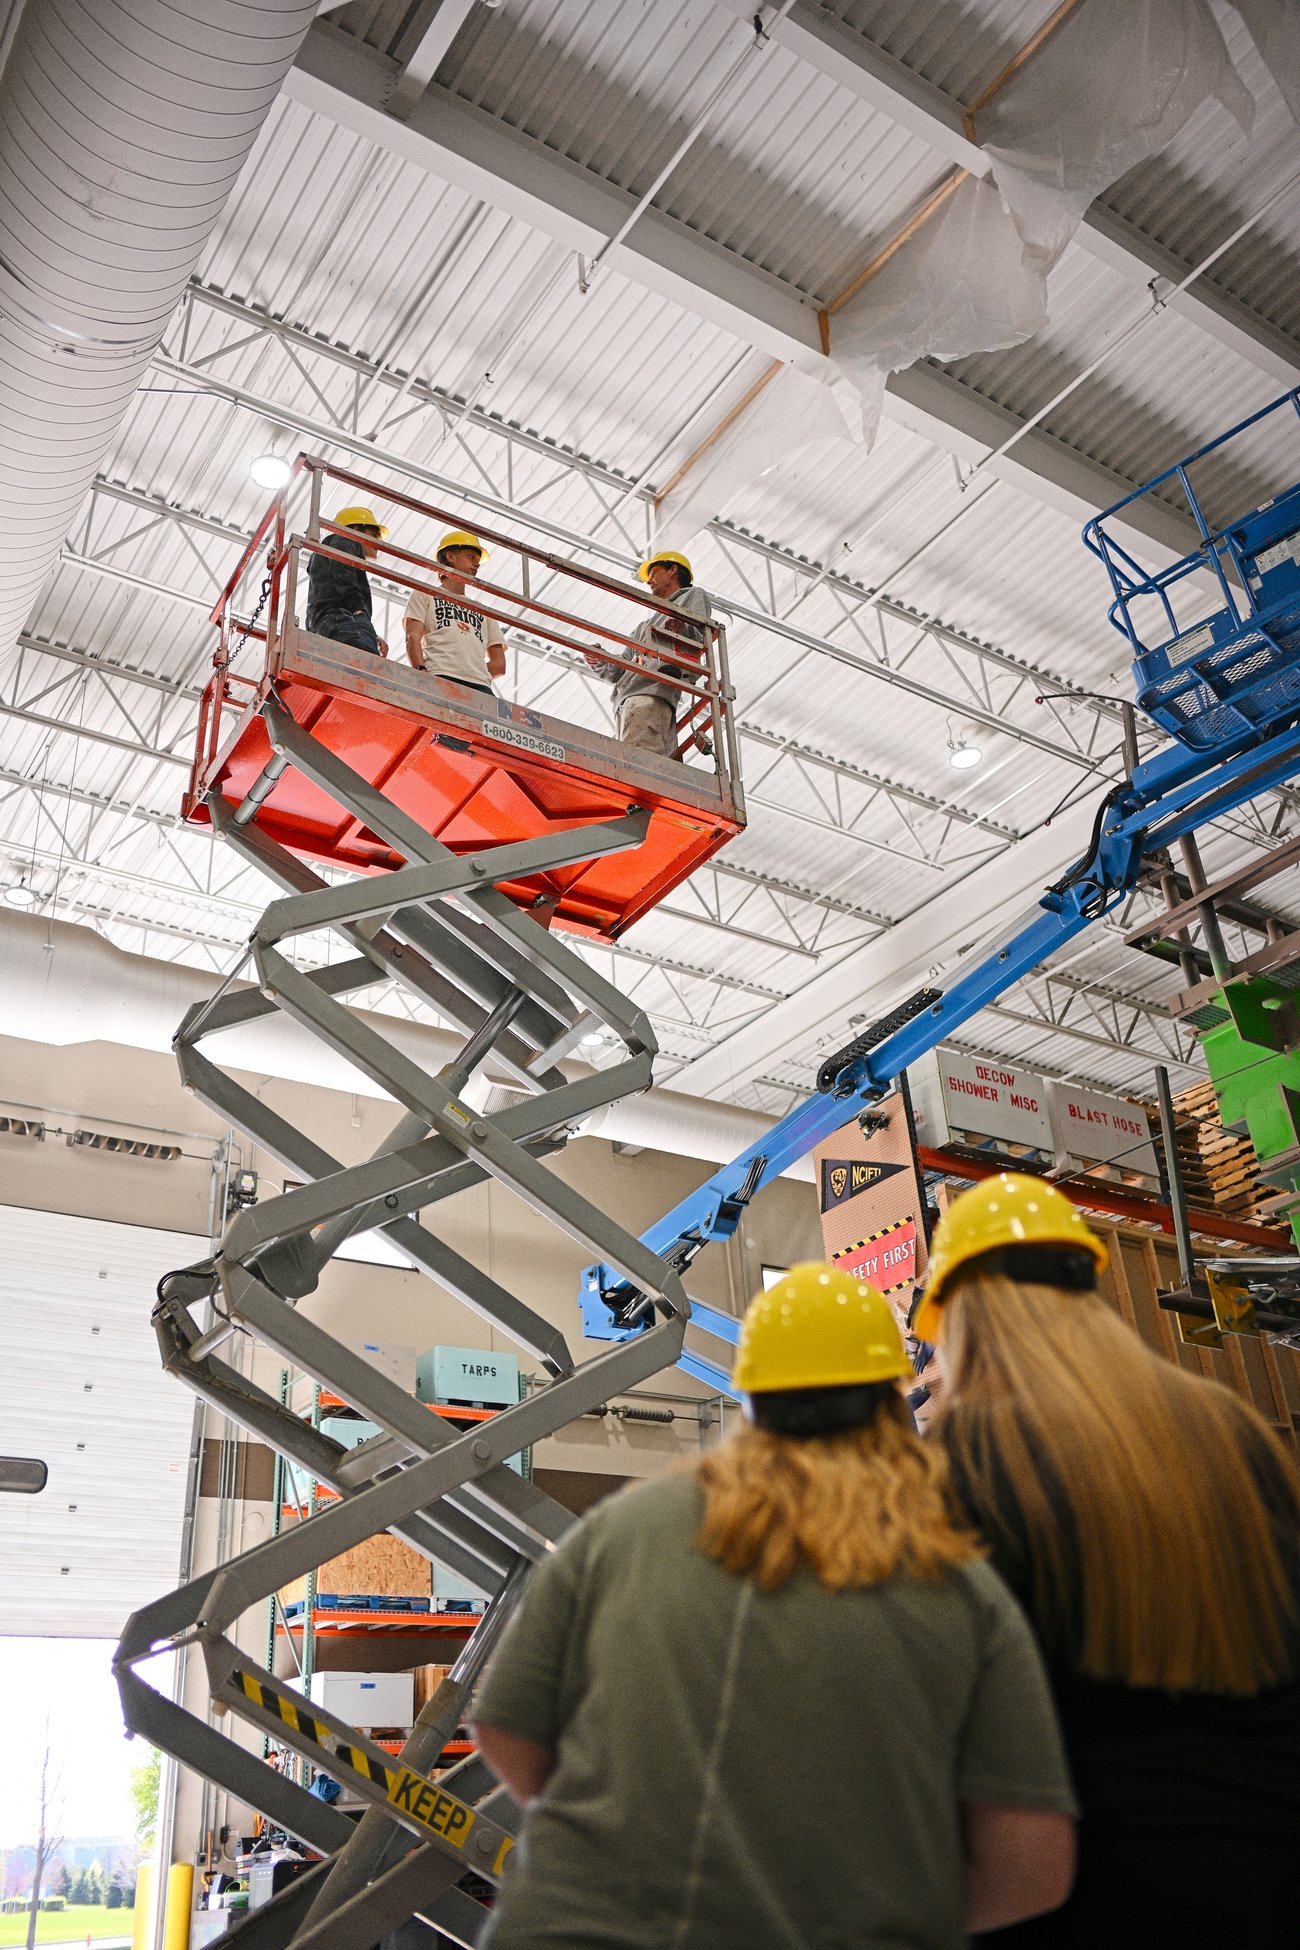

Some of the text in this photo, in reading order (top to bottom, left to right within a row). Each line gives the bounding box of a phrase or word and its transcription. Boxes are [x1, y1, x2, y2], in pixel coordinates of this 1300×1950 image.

[434, 606, 482, 631] SENIOR
[436, 619, 451, 630] 20
[483, 723, 564, 760] 1-800-339-6623
[975, 1065, 1015, 1087] DECON
[948, 1077, 1038, 1113] SHOWER MISC
[1068, 1103, 1143, 1137] BLAST HOSE
[883, 1239, 915, 1269] FIRST
[461, 1363, 497, 1377] TARPS
[393, 1772, 468, 1836] KEEP
